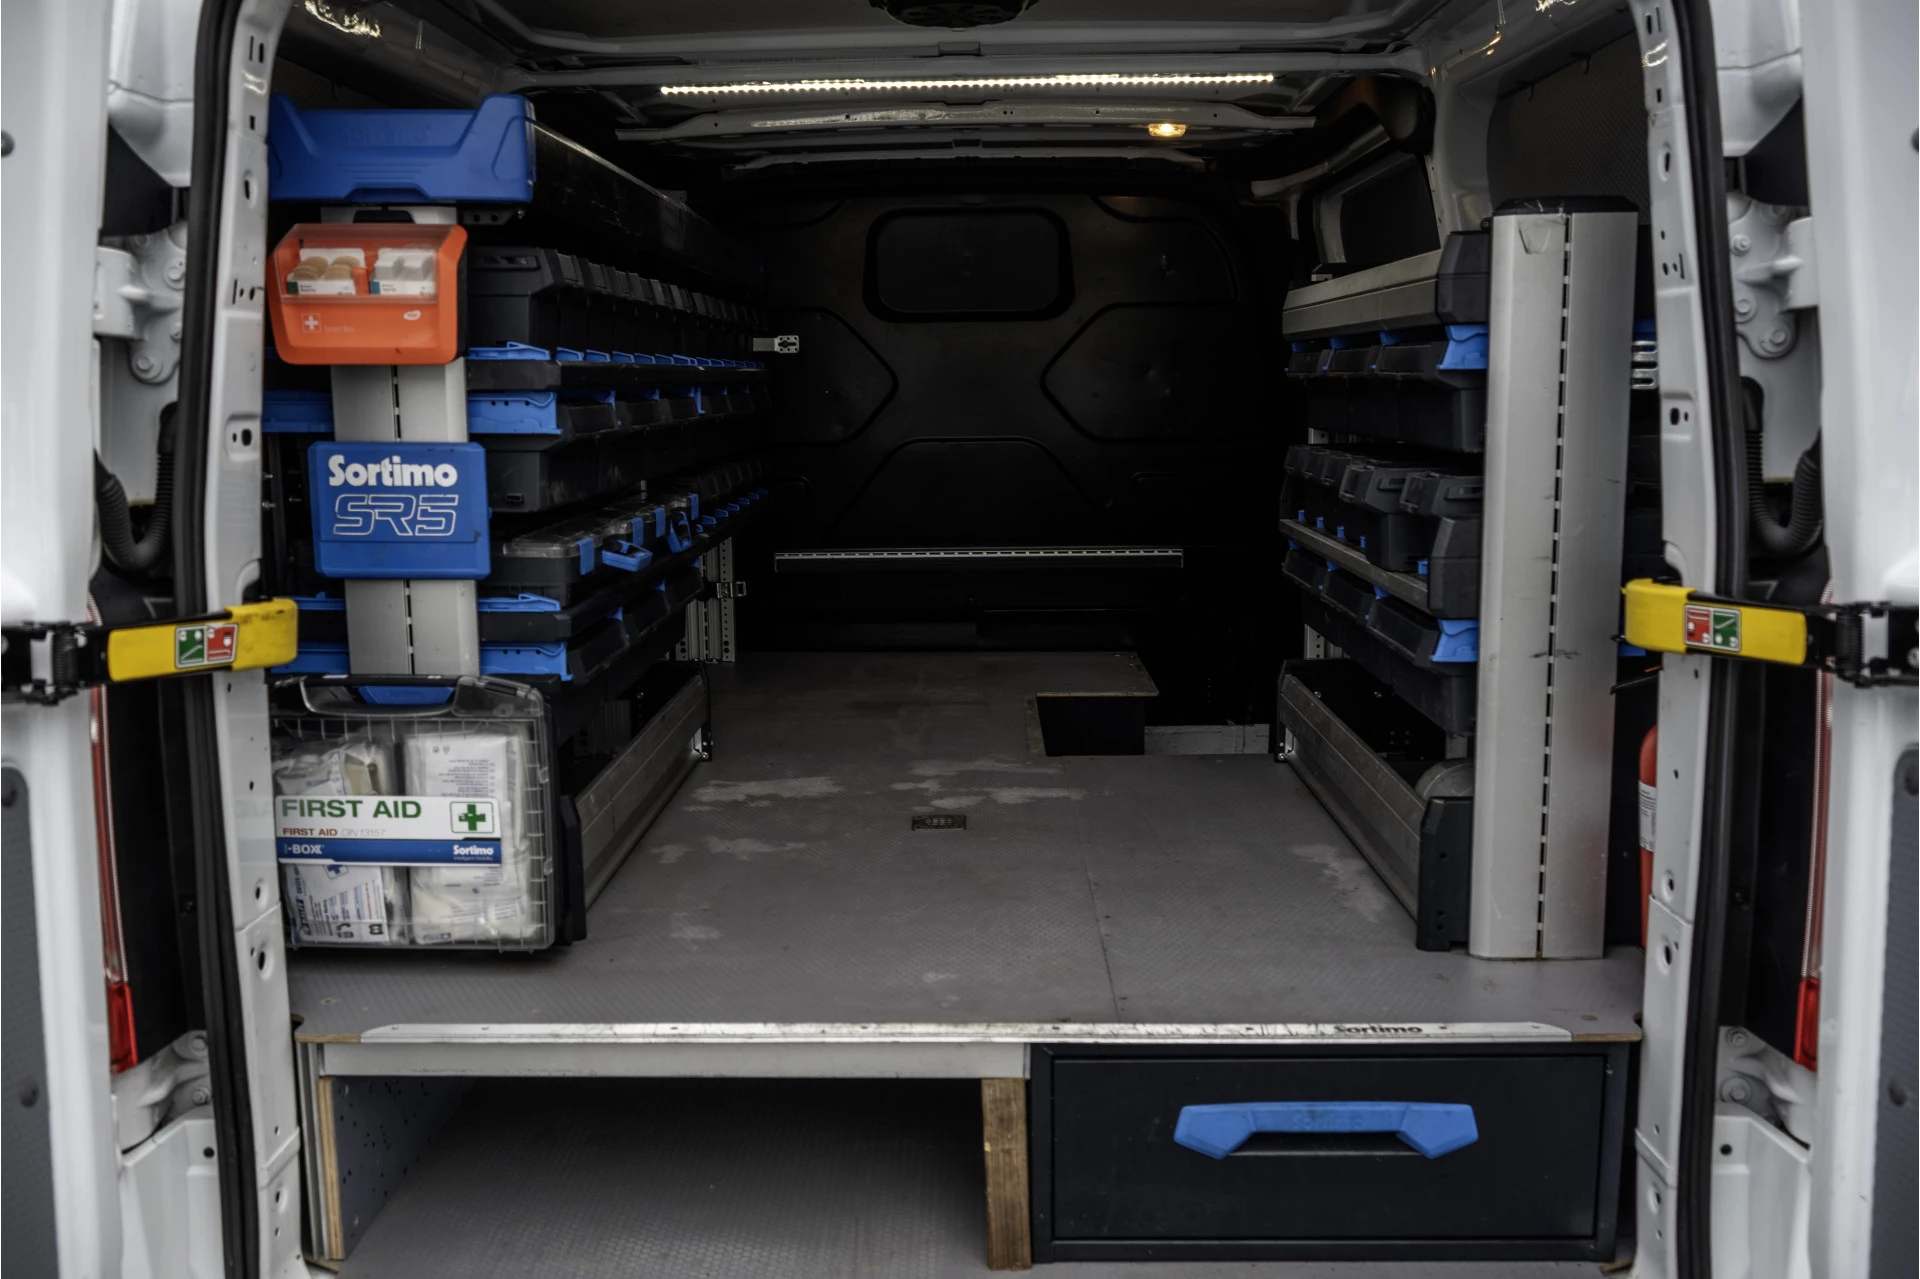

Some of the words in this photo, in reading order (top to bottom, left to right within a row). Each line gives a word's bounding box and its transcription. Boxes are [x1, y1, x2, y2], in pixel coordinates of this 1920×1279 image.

[328, 454, 458, 487] Sortimo
[333, 493, 459, 536] SR5
[281, 798, 363, 818] FIRST
[372, 800, 422, 819] AID
[282, 828, 315, 836] FIRST
[318, 828, 338, 836] AID
[452, 844, 494, 856] Sortimo
[1333, 1023, 1422, 1033] Sortimo
